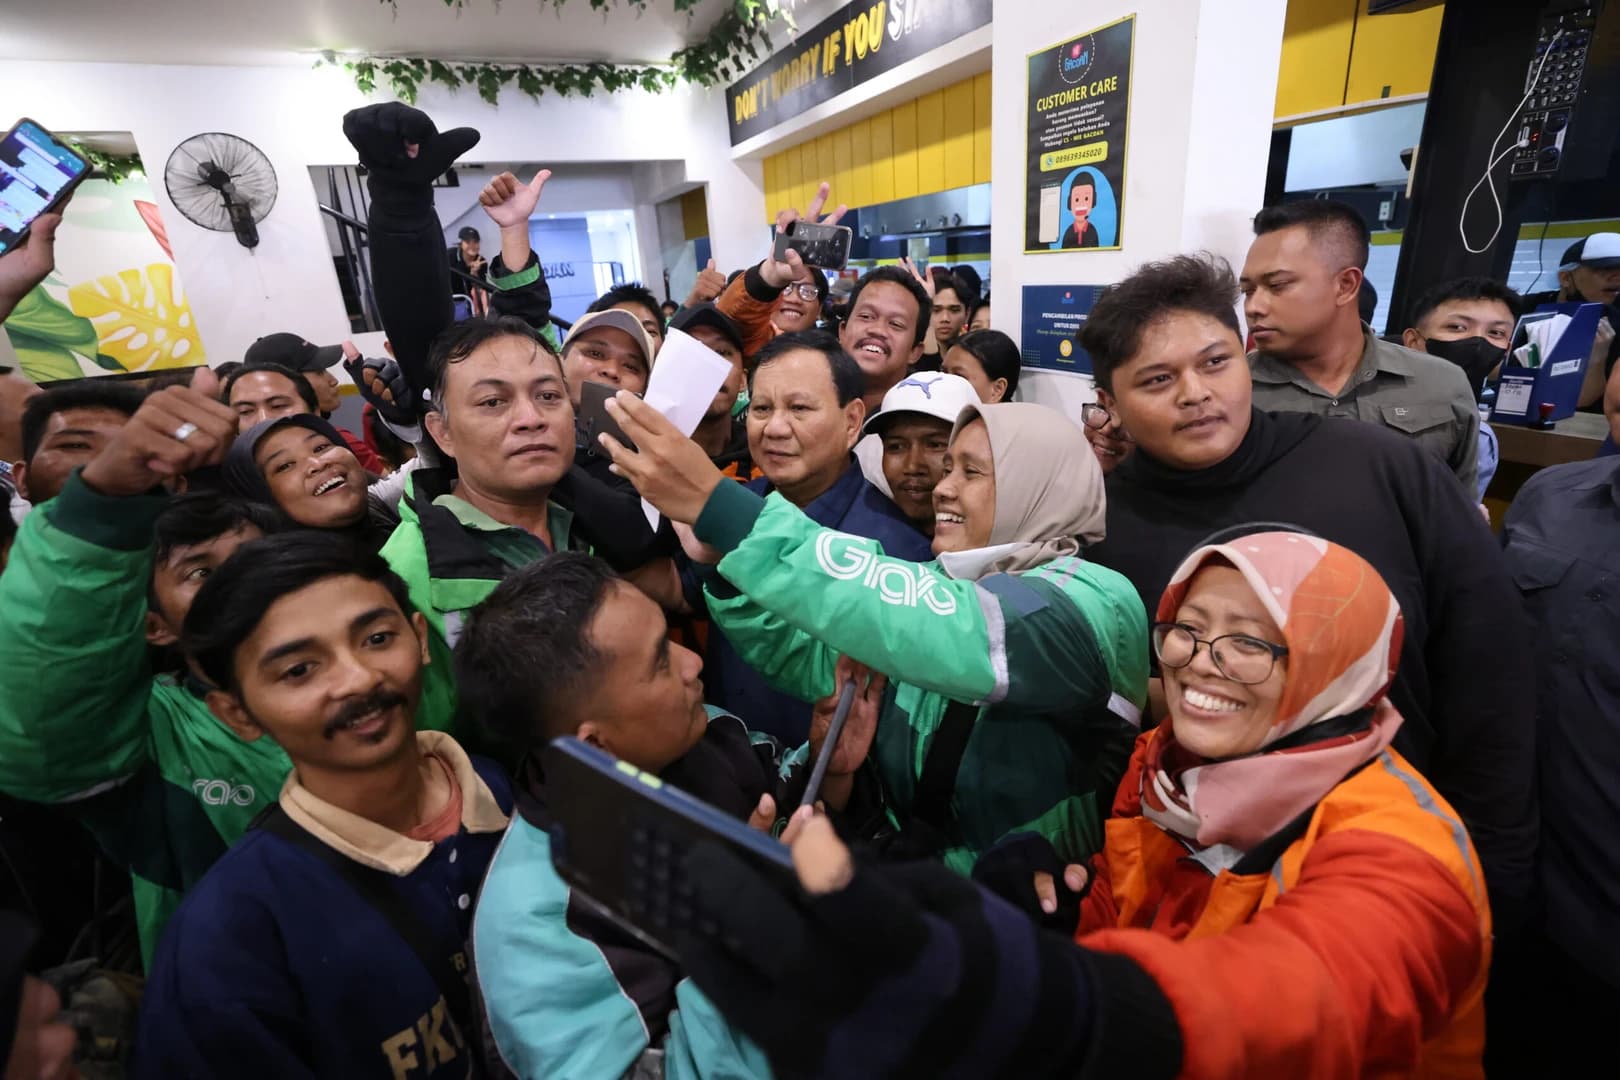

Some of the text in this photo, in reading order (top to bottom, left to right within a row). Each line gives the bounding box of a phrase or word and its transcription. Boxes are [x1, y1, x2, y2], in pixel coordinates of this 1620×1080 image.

[735, 77, 769, 124] DON'T
[771, 42, 820, 101] WORRY
[822, 29, 841, 78] IF
[844, 0, 887, 66] YOU
[1036, 76, 1118, 112] CUSTOMER CARE
[815, 531, 957, 616] Grab
